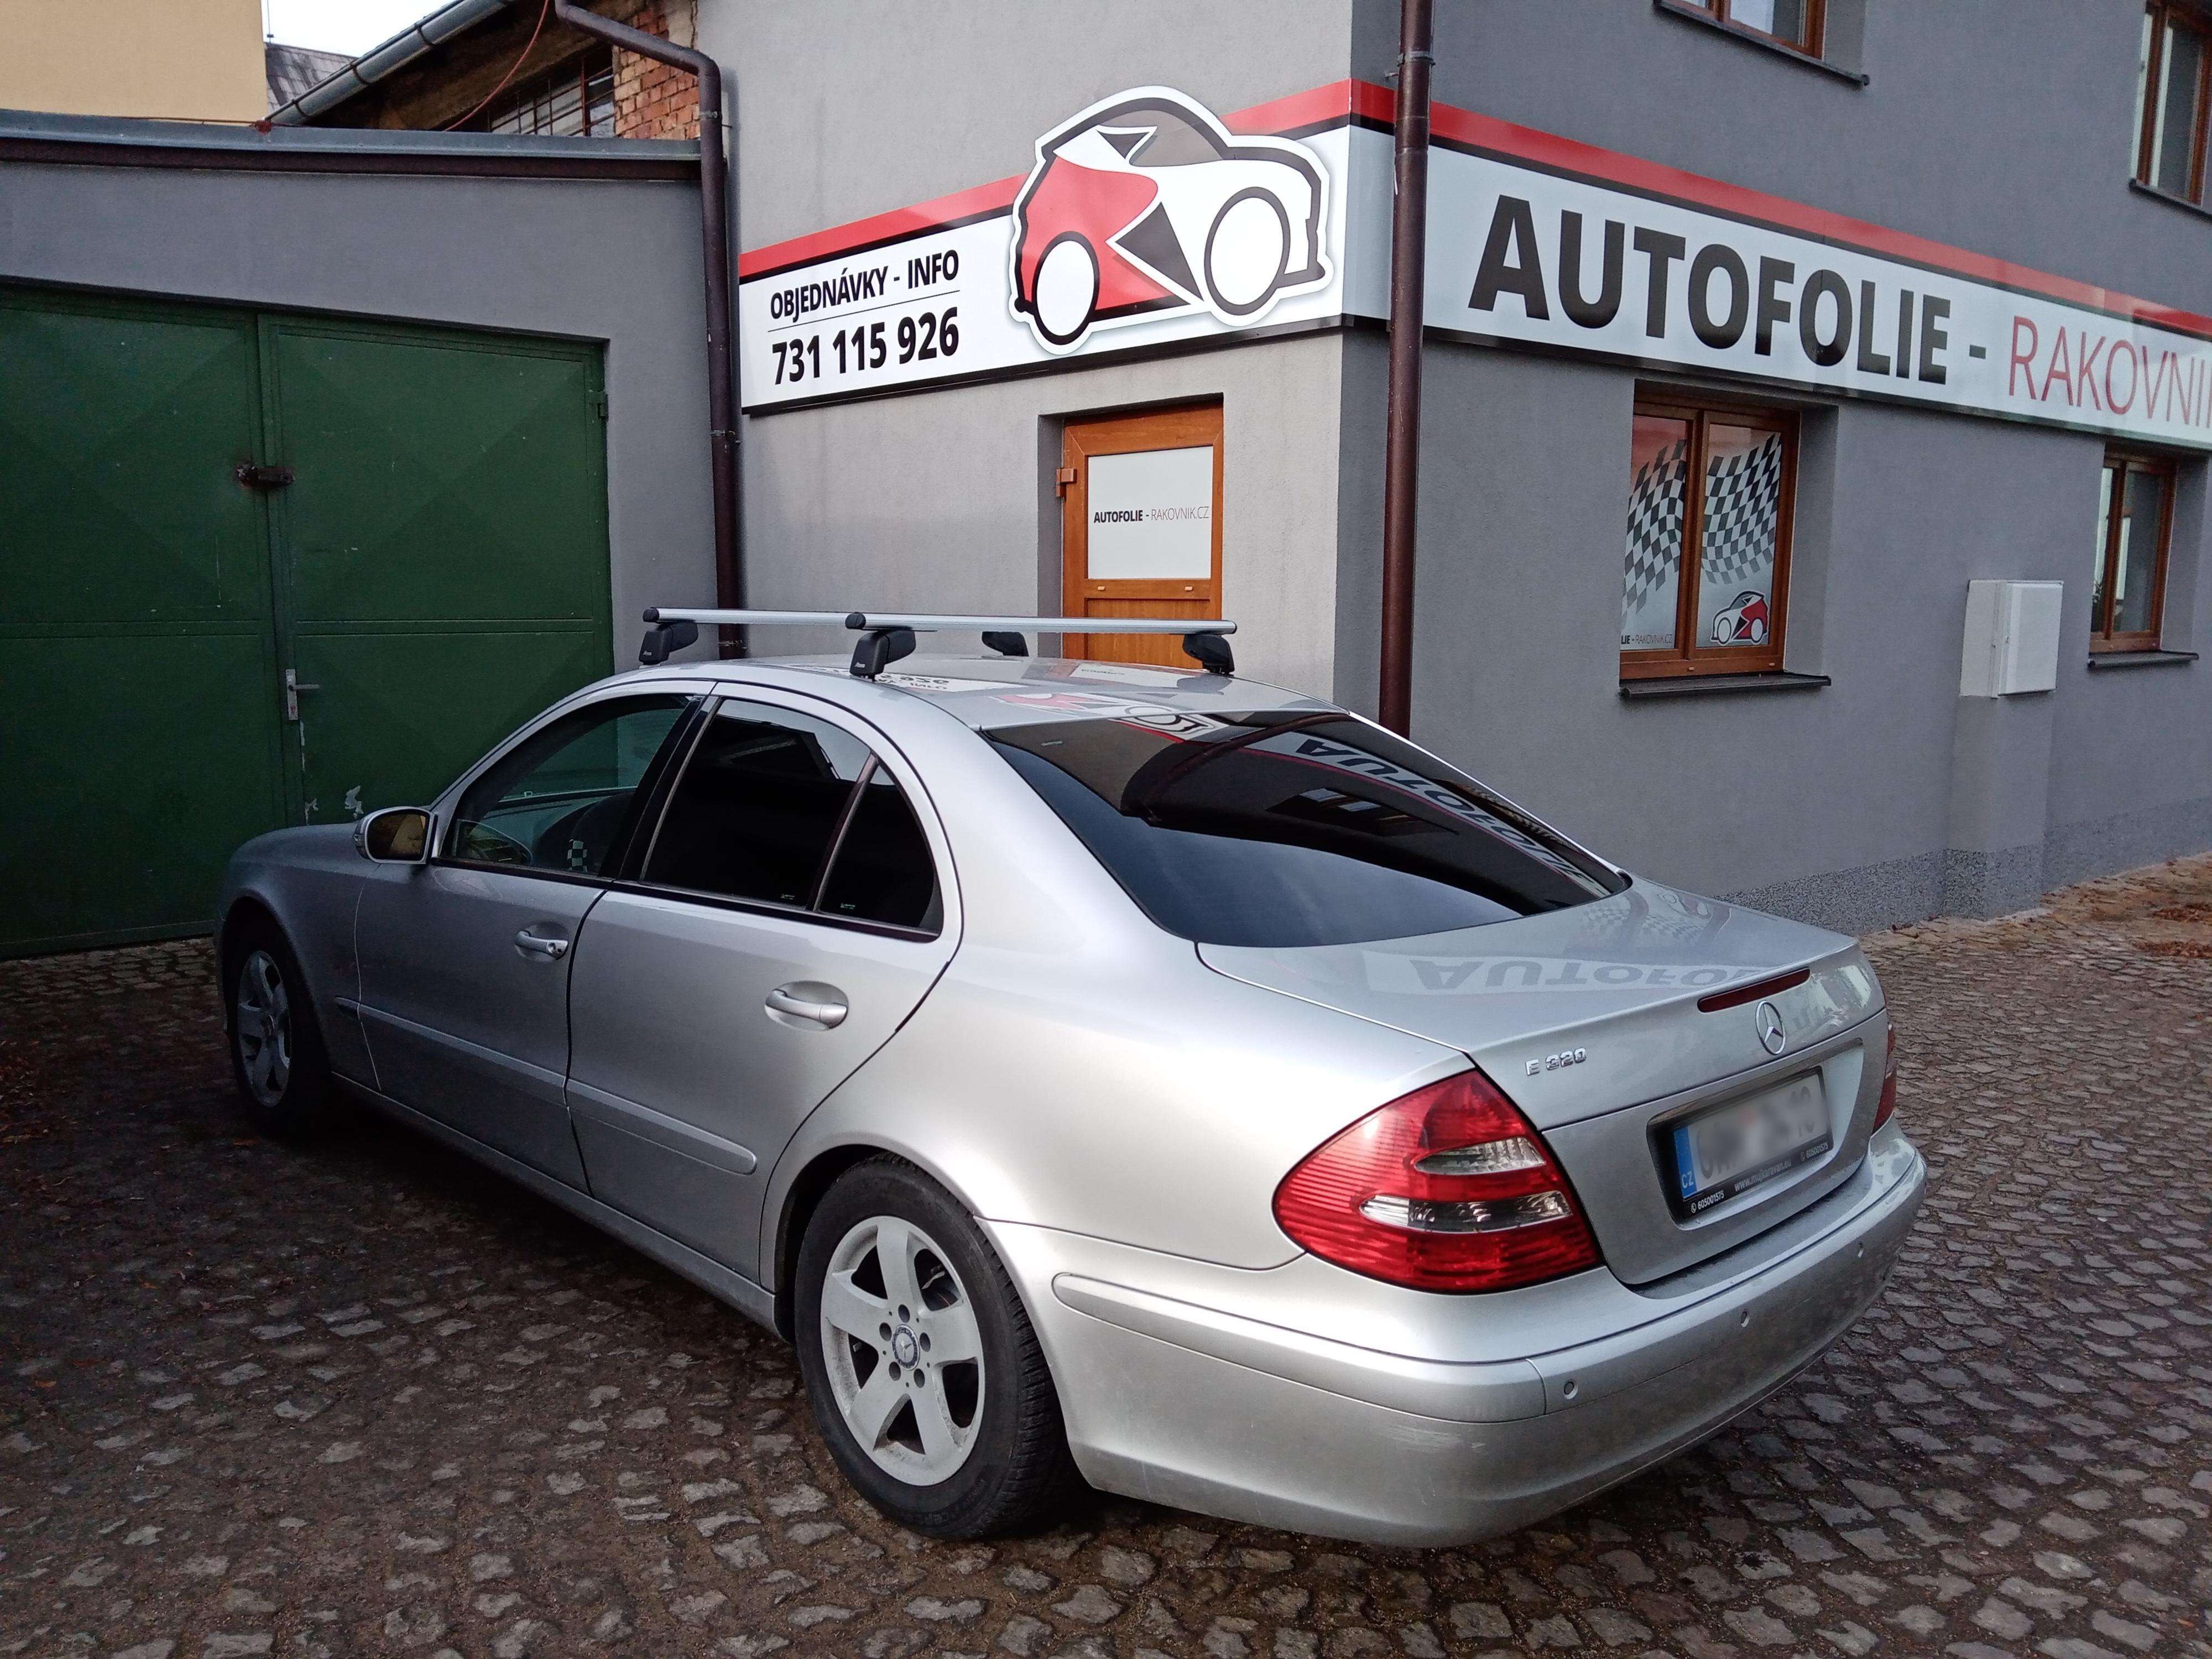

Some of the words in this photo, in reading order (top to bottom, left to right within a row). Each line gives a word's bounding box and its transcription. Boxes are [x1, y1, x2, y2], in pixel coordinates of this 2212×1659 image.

[770, 266, 889, 323] OBJEDNÁVKY
[907, 249, 959, 290] INFO
[1468, 194, 1951, 385] AUTOFOLIE
[1969, 344, 1986, 359] -
[772, 335, 820, 385] 731
[832, 321, 887, 374] 115
[898, 306, 959, 364] 926
[1093, 509, 1144, 524] AUTOFOLIE
[1151, 506, 1209, 521] RAKOVNIK.CZ
[1525, 1058, 1540, 1076] E
[1545, 1047, 1587, 1071] 320
[1681, 1170, 1694, 1188] CZ
[1697, 1190, 1725, 1210] 605001575
